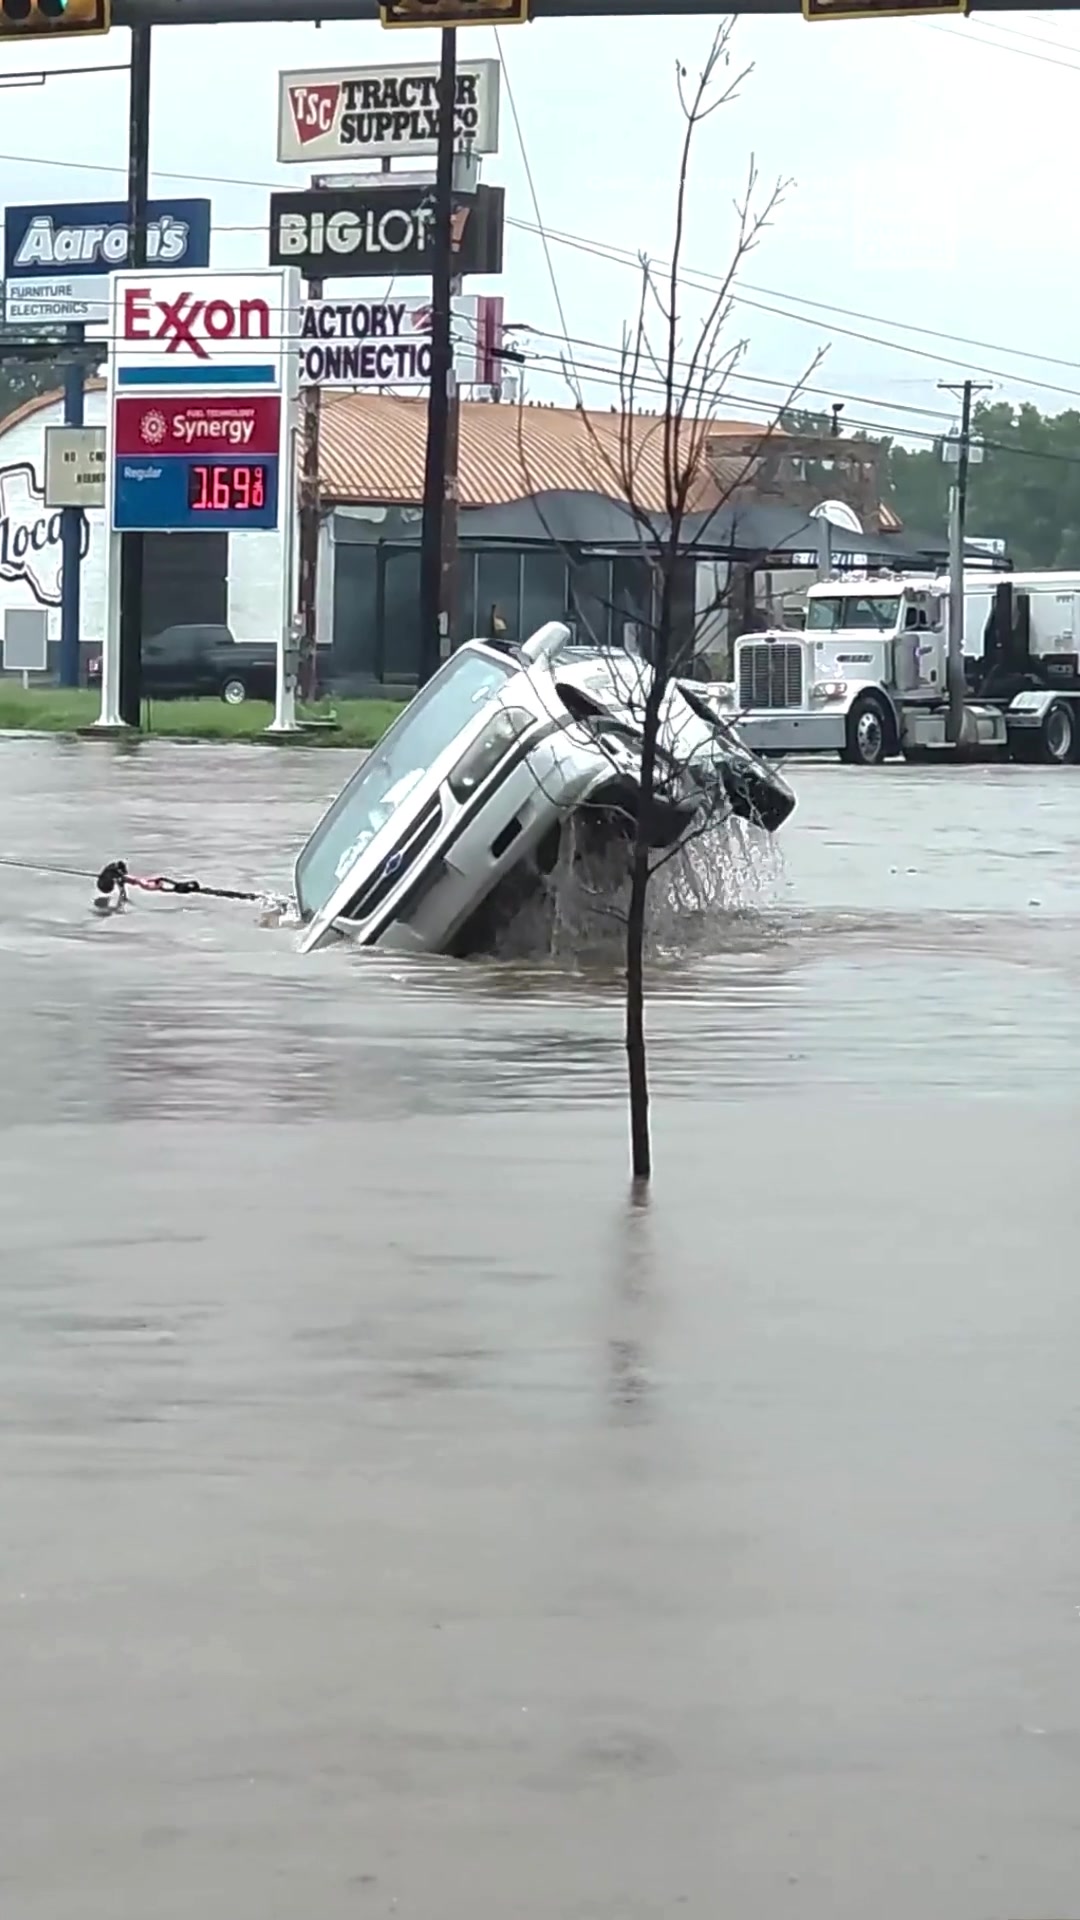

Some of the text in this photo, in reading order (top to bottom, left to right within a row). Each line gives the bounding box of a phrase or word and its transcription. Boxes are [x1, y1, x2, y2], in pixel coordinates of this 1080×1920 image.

[295, 89, 331, 130] TSC
[342, 75, 476, 110] TRACTR
[10, 285, 72, 297] FURNITURE
[10, 302, 89, 316] ELECTRONICS
[124, 289, 269, 360] Exxon
[300, 304, 405, 338] ACTORY
[299, 345, 432, 379] ONNECTIO
[173, 415, 255, 443] Synergy
[124, 466, 163, 481] Regular
[0, 512, 64, 571] Loca
